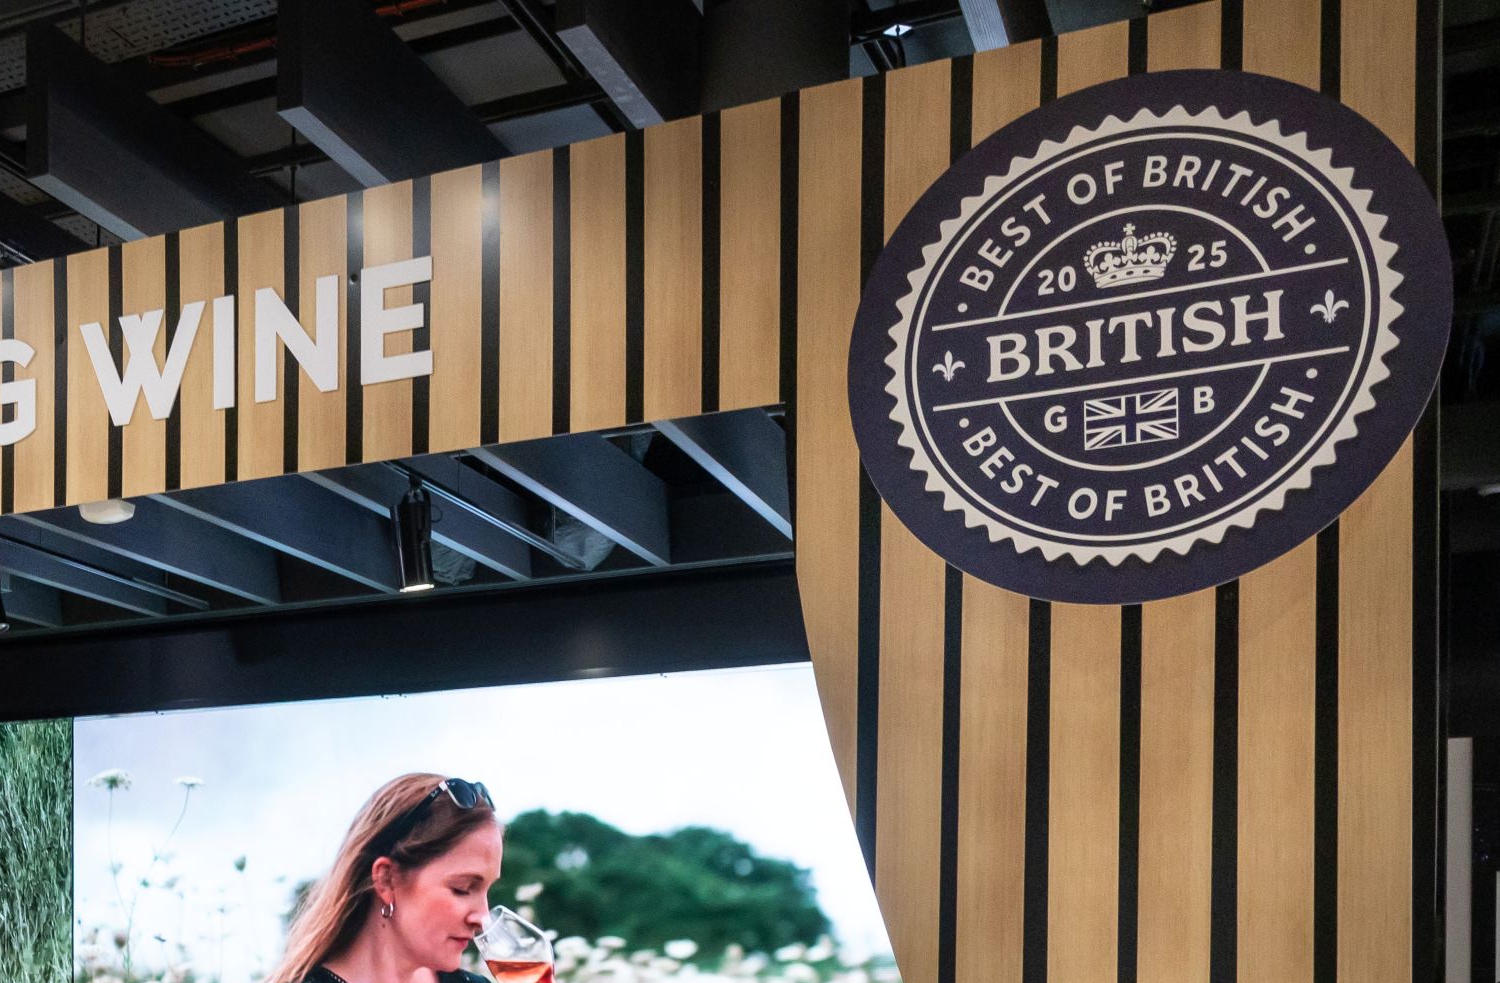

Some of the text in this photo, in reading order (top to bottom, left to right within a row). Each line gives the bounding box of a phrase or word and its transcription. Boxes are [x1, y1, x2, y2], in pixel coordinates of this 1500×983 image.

[960, 156, 1316, 291] BEST OF BRITISH
[1037, 240, 1228, 296] 20 25
[79, 255, 433, 427] WINE
[986, 290, 1286, 383] BRITISH
[961, 385, 1316, 522] BEST OF BRITISH
[1043, 386, 1216, 434] G B
